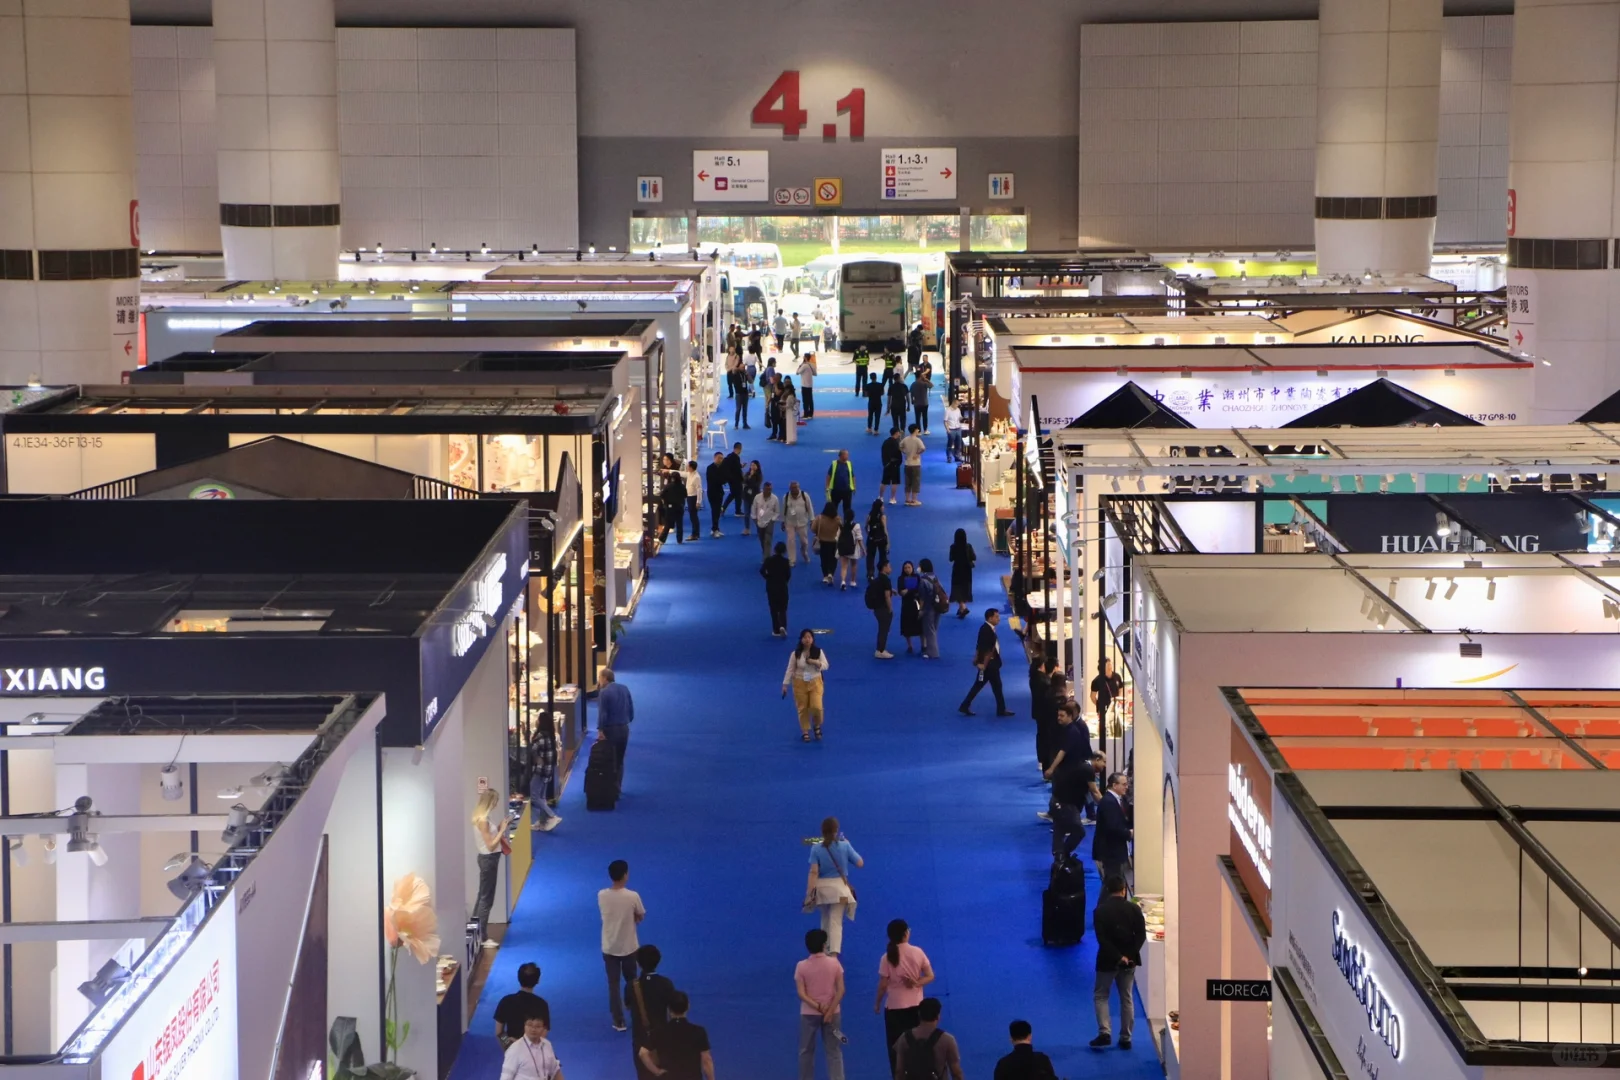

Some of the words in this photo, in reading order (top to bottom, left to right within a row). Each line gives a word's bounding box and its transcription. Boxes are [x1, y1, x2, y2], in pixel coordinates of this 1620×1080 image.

[751, 70, 865, 140] 4.1
[727, 156, 741, 166] 5.1
[898, 154, 928, 164] 1.1-3.1
[116, 297, 133, 306] MORE
[1507, 299, 1530, 314] 参观
[1380, 535, 1540, 553] HUAGNG
[0, 666, 105, 691] XIANG
[1212, 983, 1270, 997] HORECA
